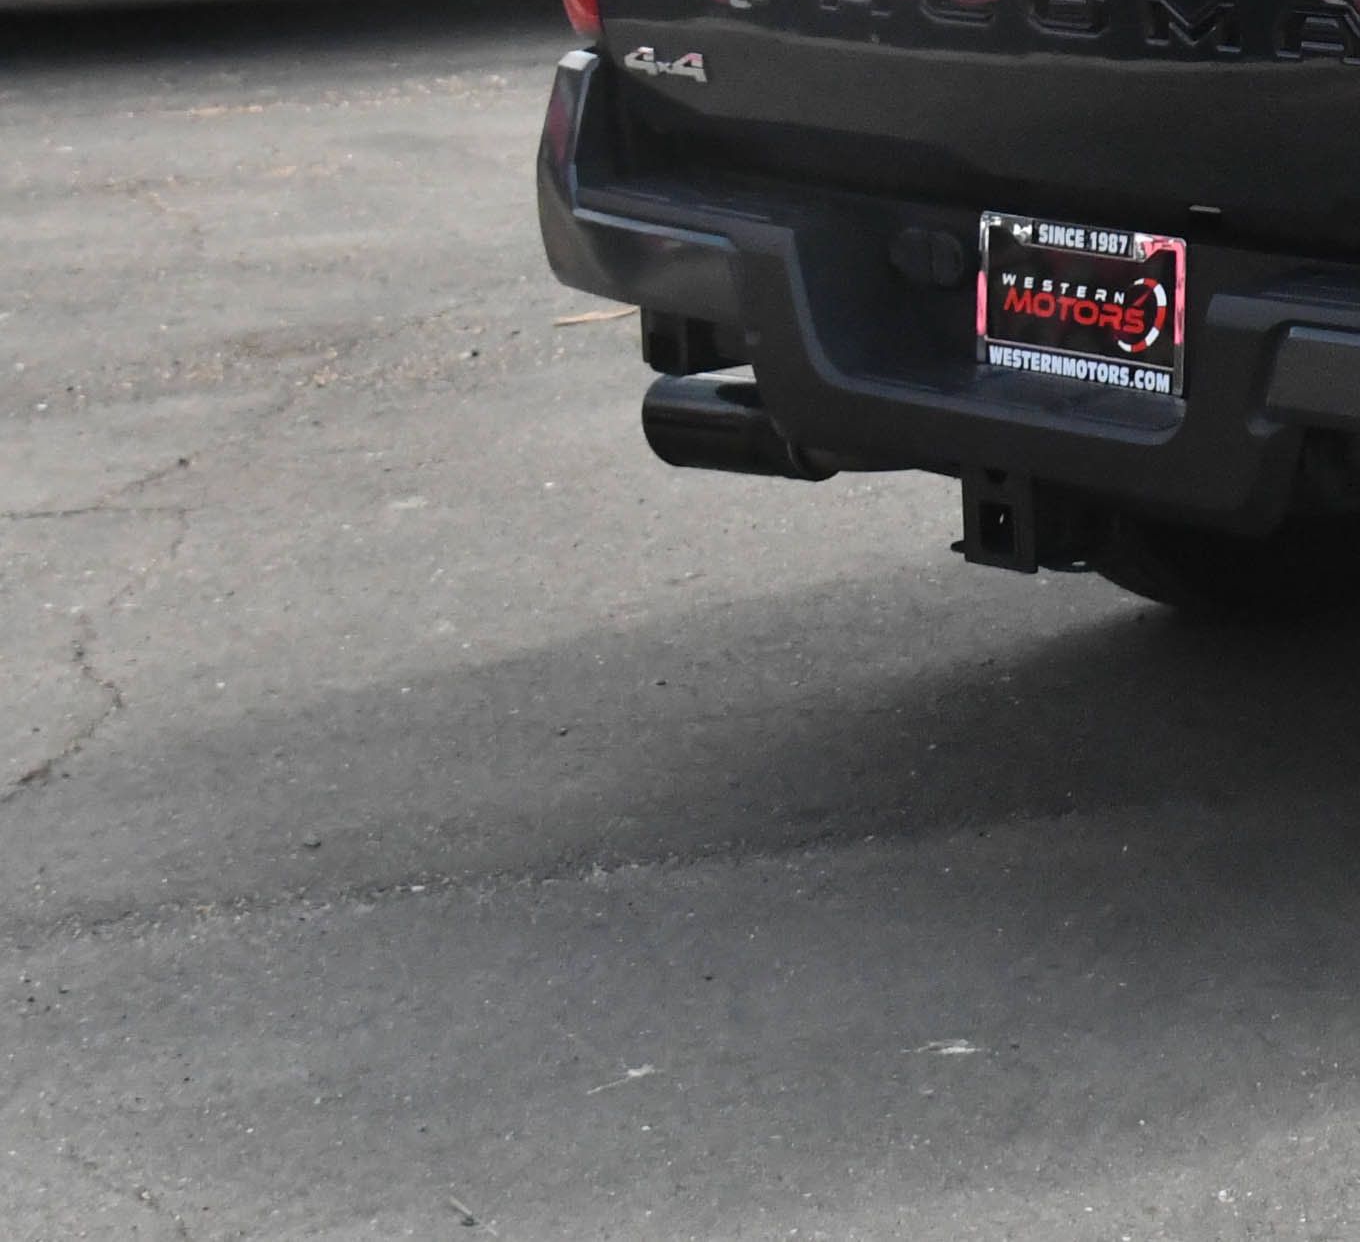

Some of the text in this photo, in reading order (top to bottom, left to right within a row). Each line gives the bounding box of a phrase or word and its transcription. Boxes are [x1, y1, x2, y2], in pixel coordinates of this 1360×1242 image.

[1038, 223, 1129, 256] SINCE 1987
[1002, 272, 1126, 305] WESTERN
[1003, 287, 1146, 335] MOTORS
[988, 345, 1171, 394] WESTERNMOTORS.COM
